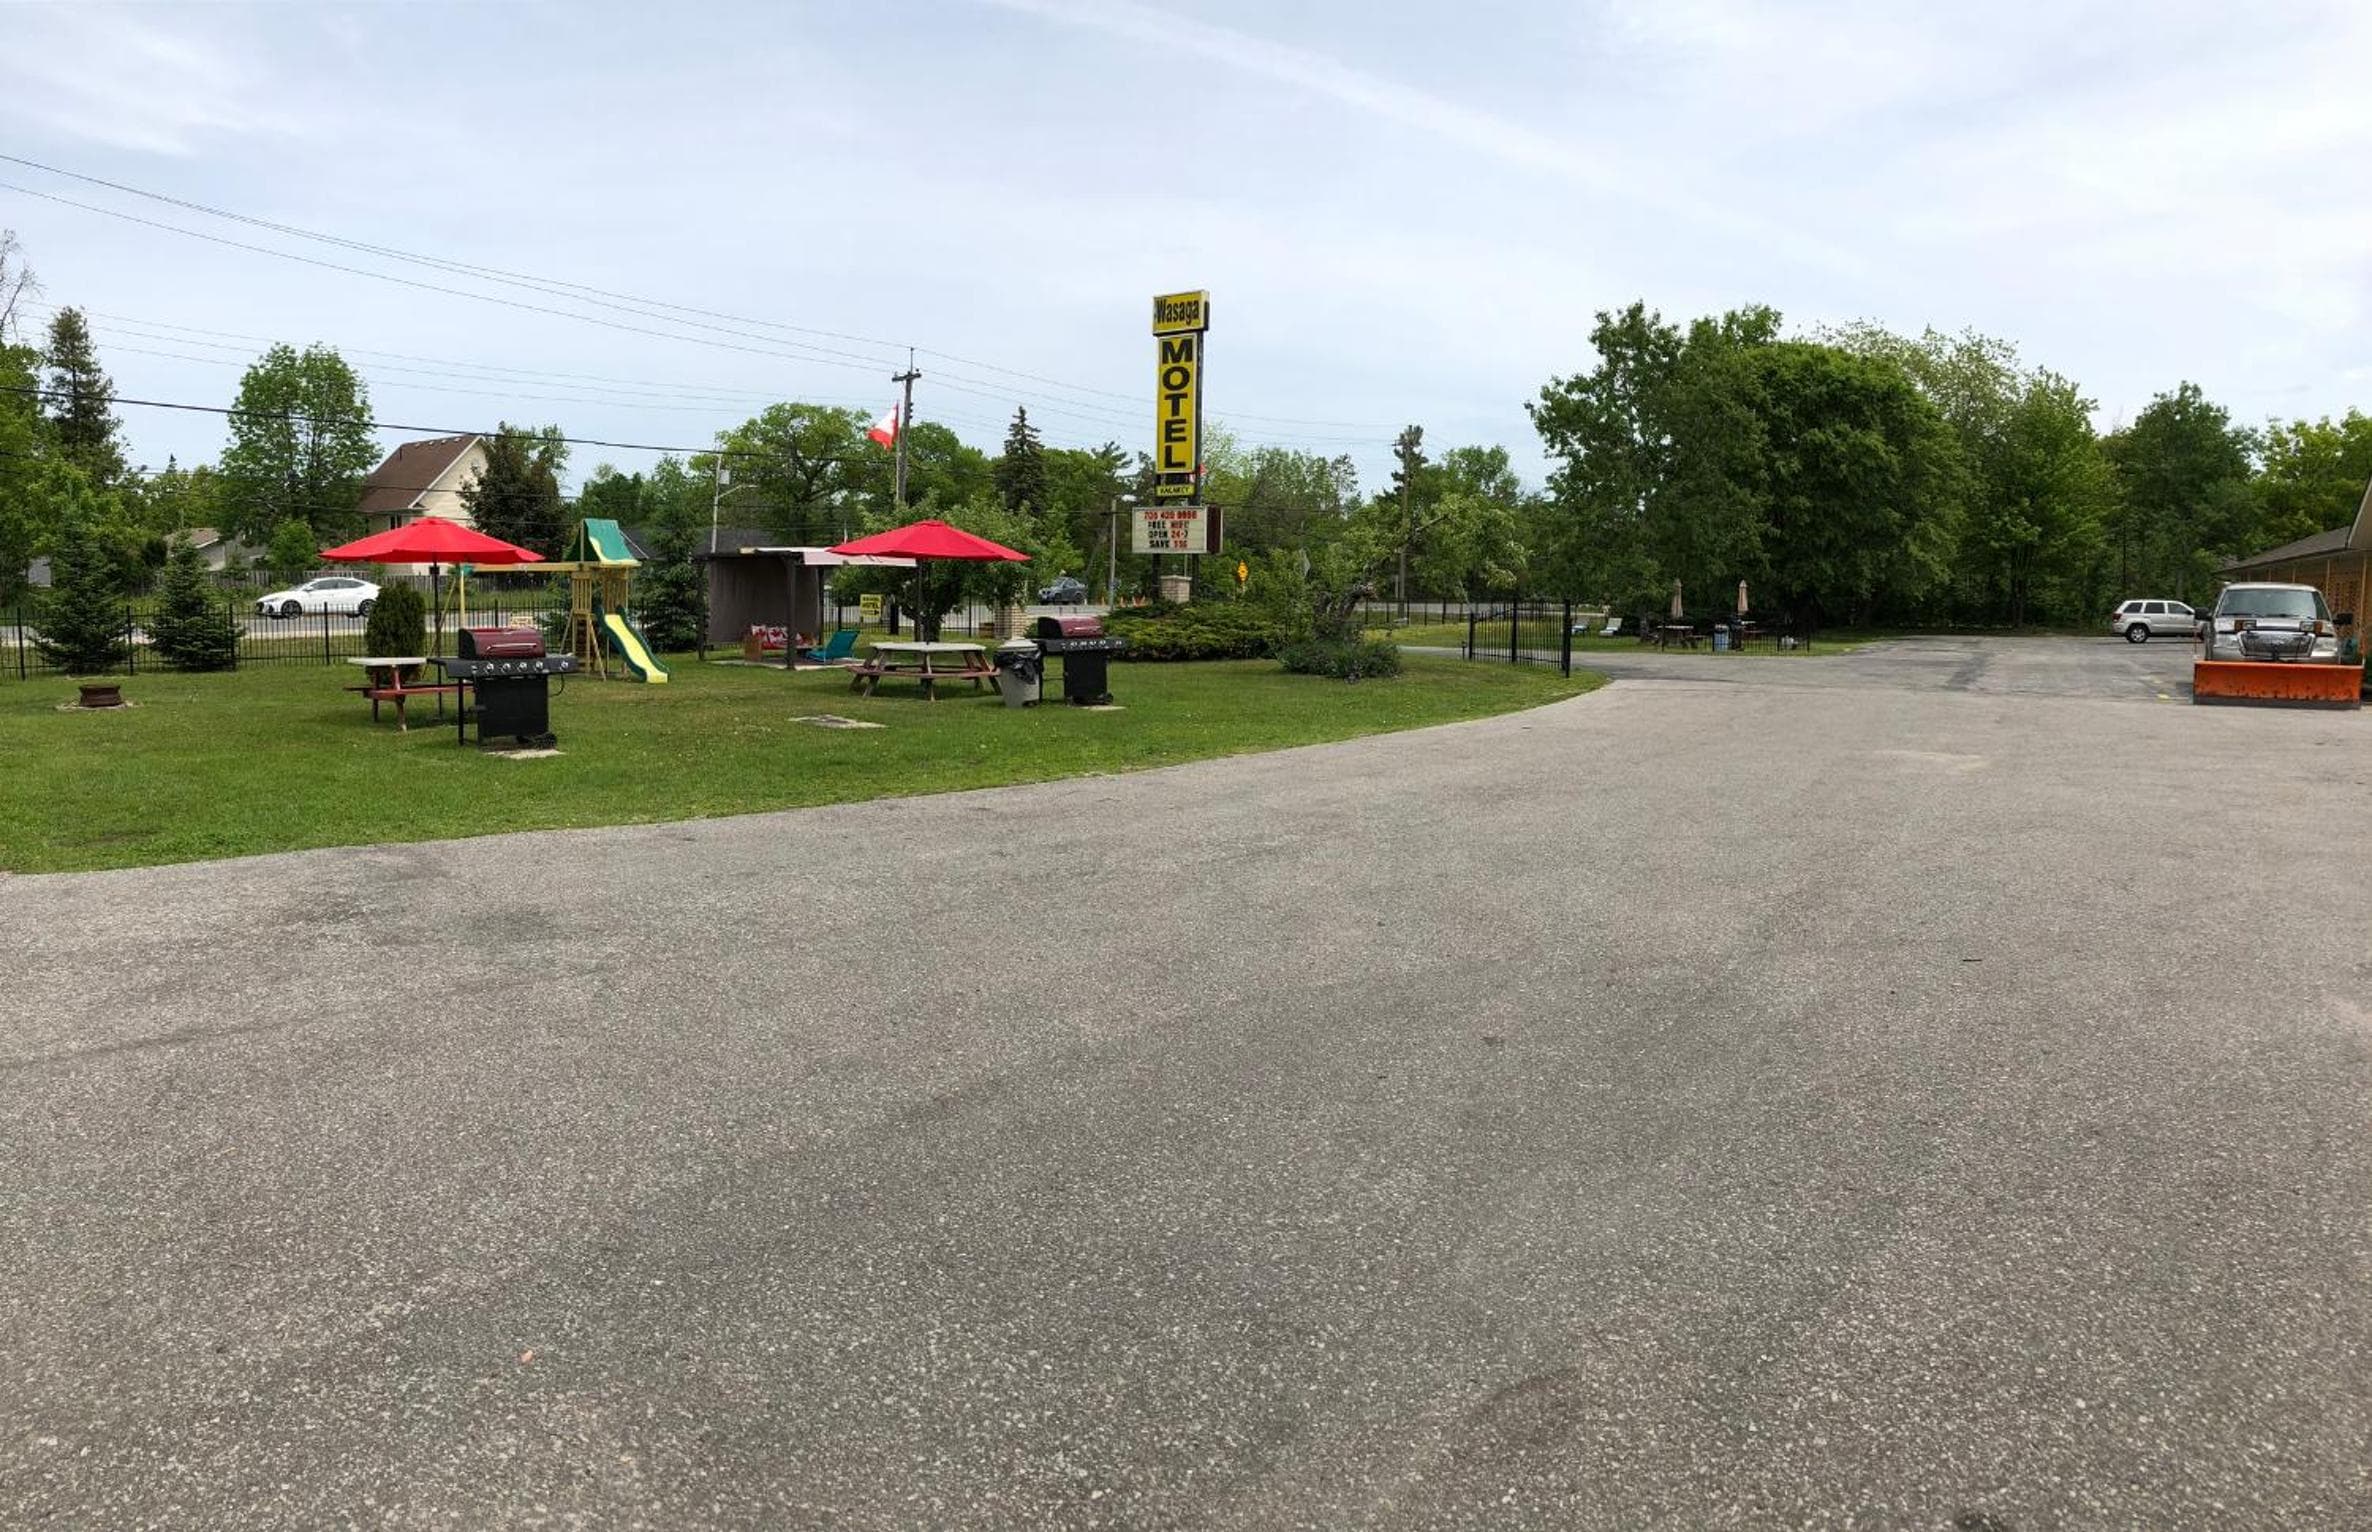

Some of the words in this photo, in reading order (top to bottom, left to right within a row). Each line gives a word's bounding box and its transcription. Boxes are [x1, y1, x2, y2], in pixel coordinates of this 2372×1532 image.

[1156, 298, 1199, 326] Wasaga
[1162, 338, 1192, 469] MOTEL
[1148, 530, 1167, 539] OPEN
[1149, 540, 1169, 548] SAVE
